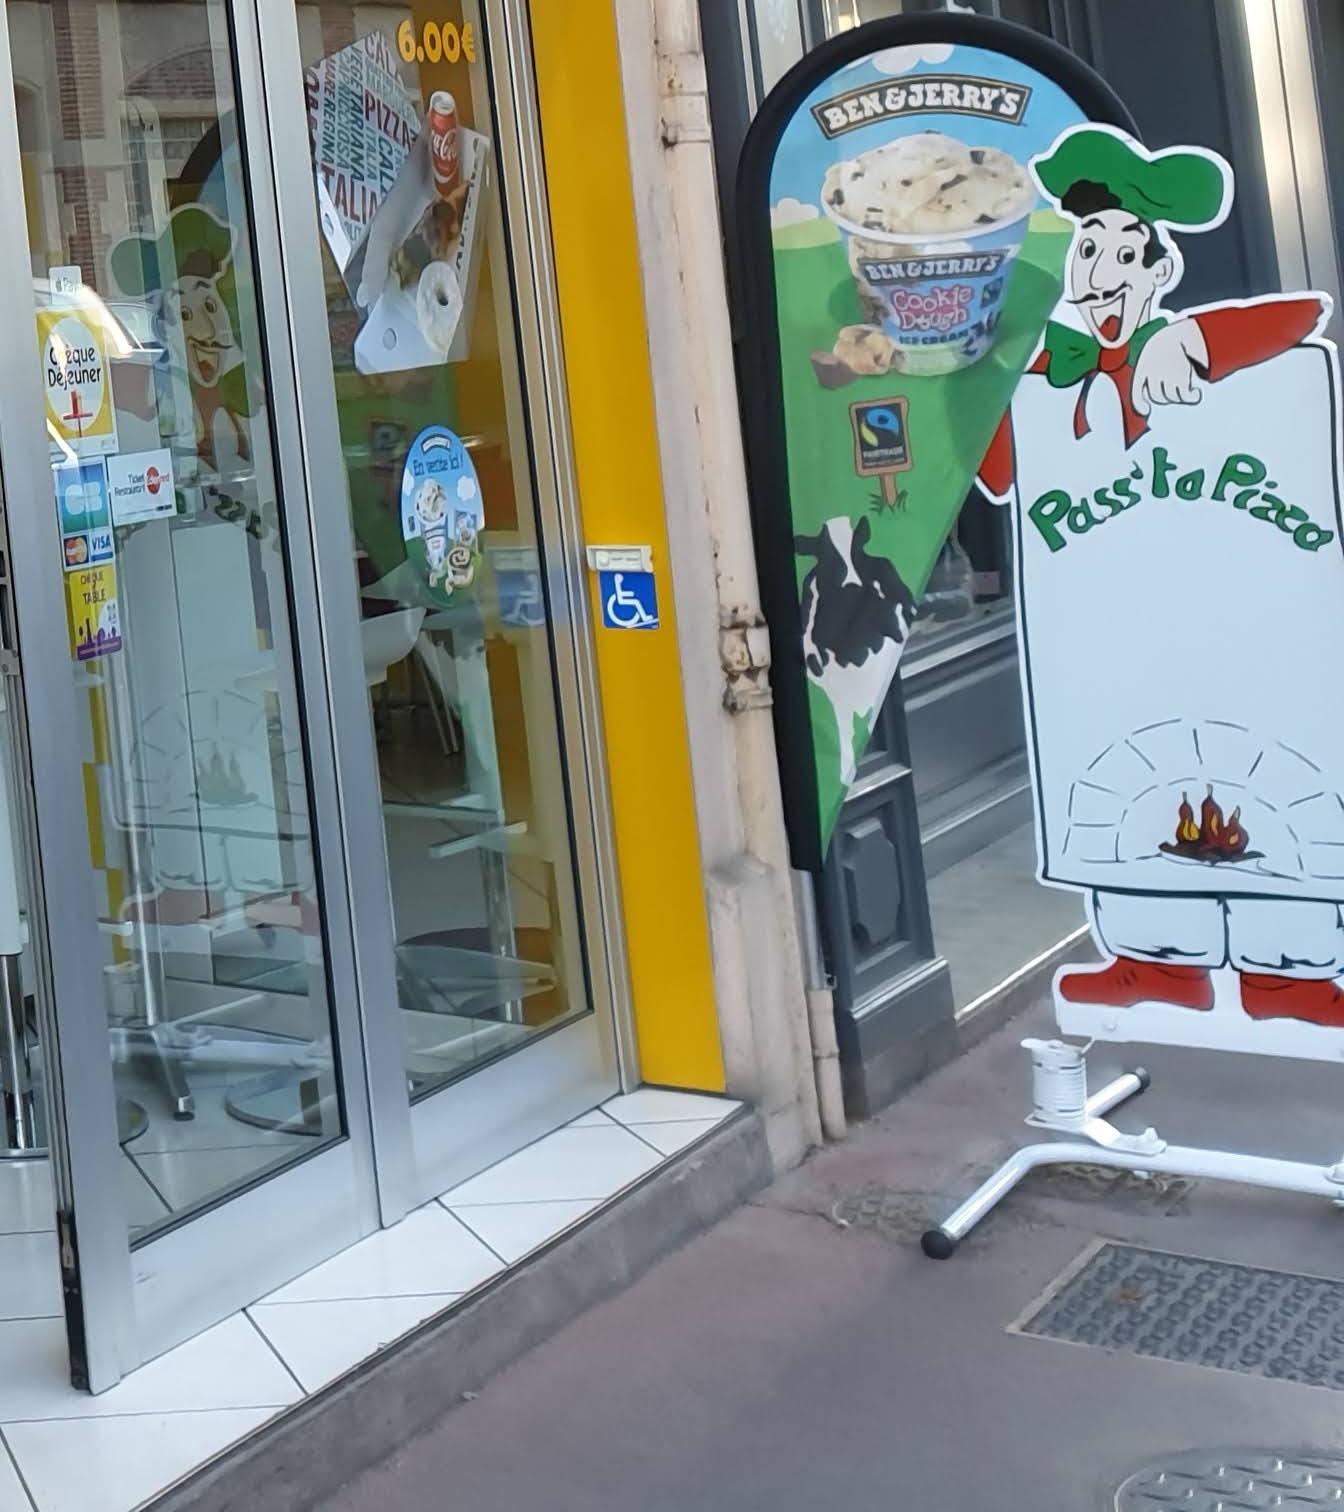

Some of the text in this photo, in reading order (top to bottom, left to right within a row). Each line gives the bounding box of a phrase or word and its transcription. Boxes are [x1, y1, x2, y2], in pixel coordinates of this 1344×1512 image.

[397, 19, 476, 64] 6.00€
[891, 286, 974, 310] Cookie
[900, 305, 969, 332] Dough
[1211, 453, 1334, 553] Pizza
[91, 537, 111, 552] VISA
